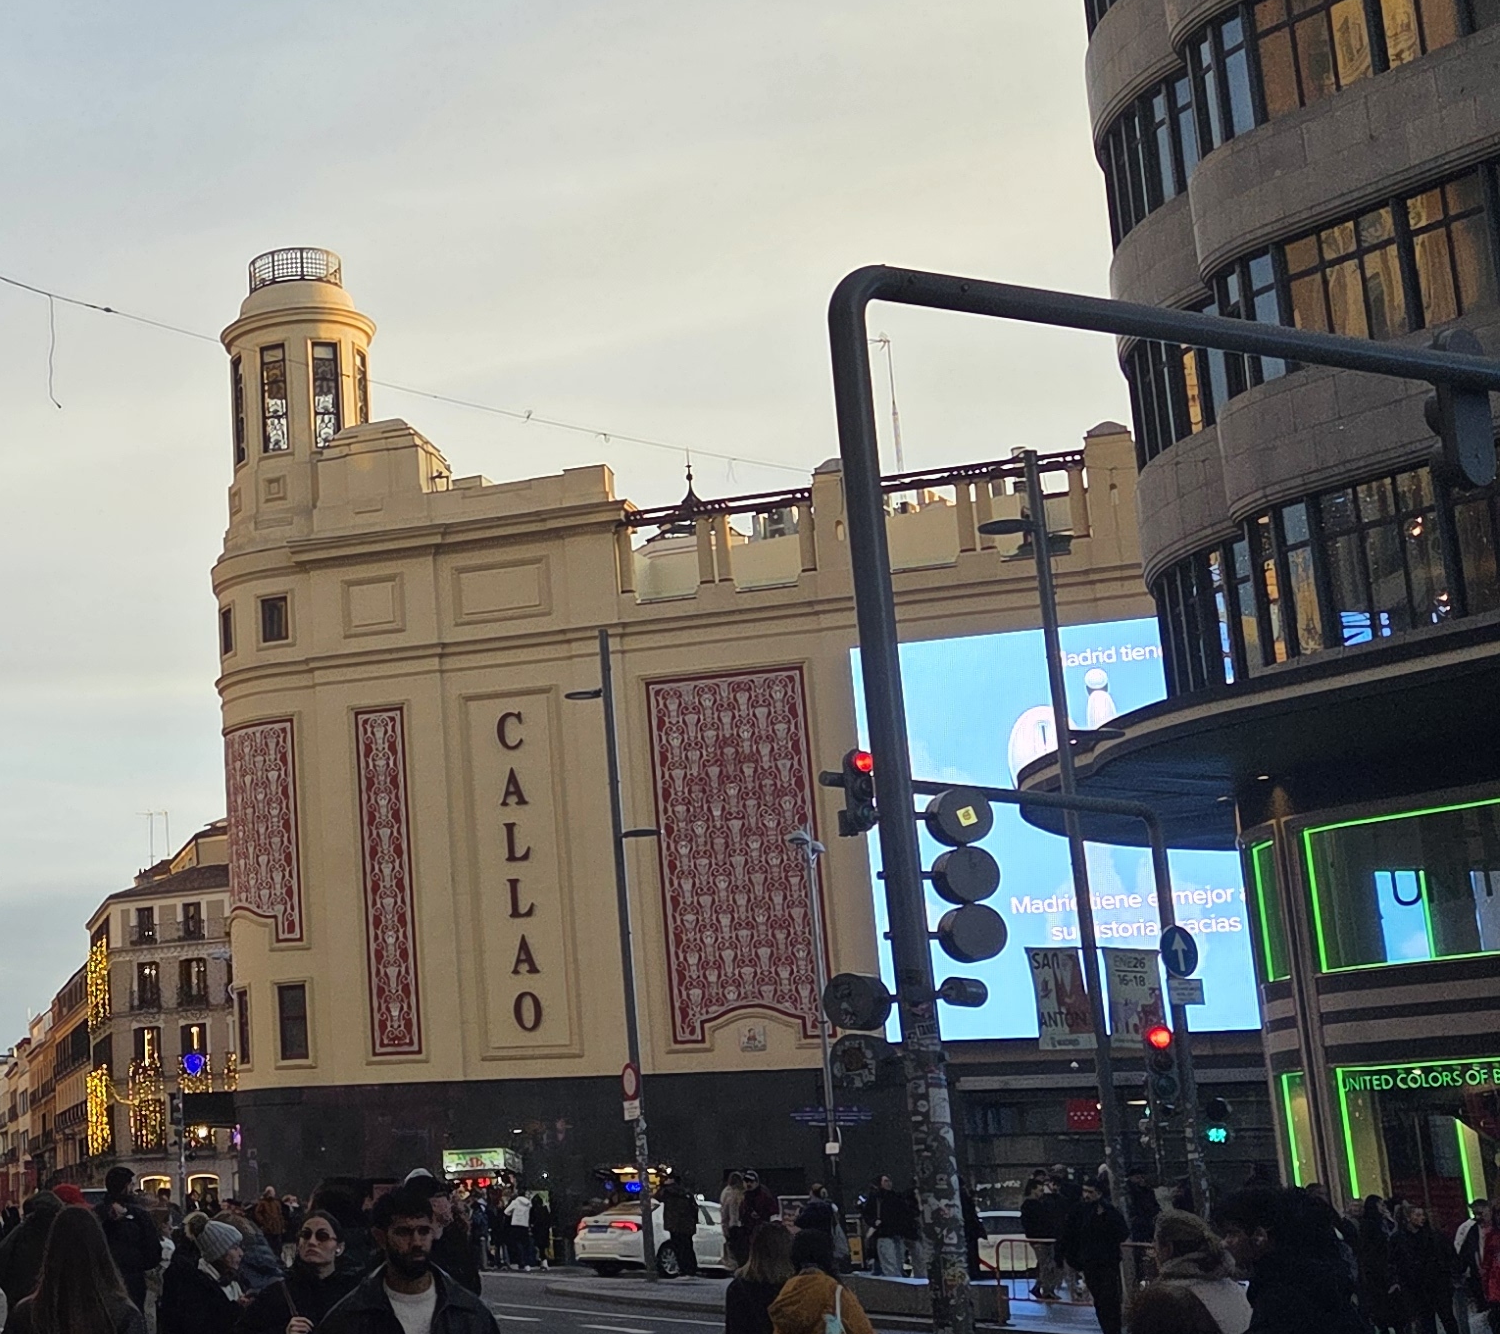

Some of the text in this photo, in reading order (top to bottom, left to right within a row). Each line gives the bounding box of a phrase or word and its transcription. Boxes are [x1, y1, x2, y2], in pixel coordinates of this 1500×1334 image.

[496, 711, 543, 1033] CALLAO
[1175, 885, 1235, 909] mejor
[1051, 914, 1243, 941] su istoria racias
[1341, 1074, 1394, 1093] UNITED
[1396, 1069, 1462, 1091] COLORS
[1465, 1069, 1489, 1086] OF
